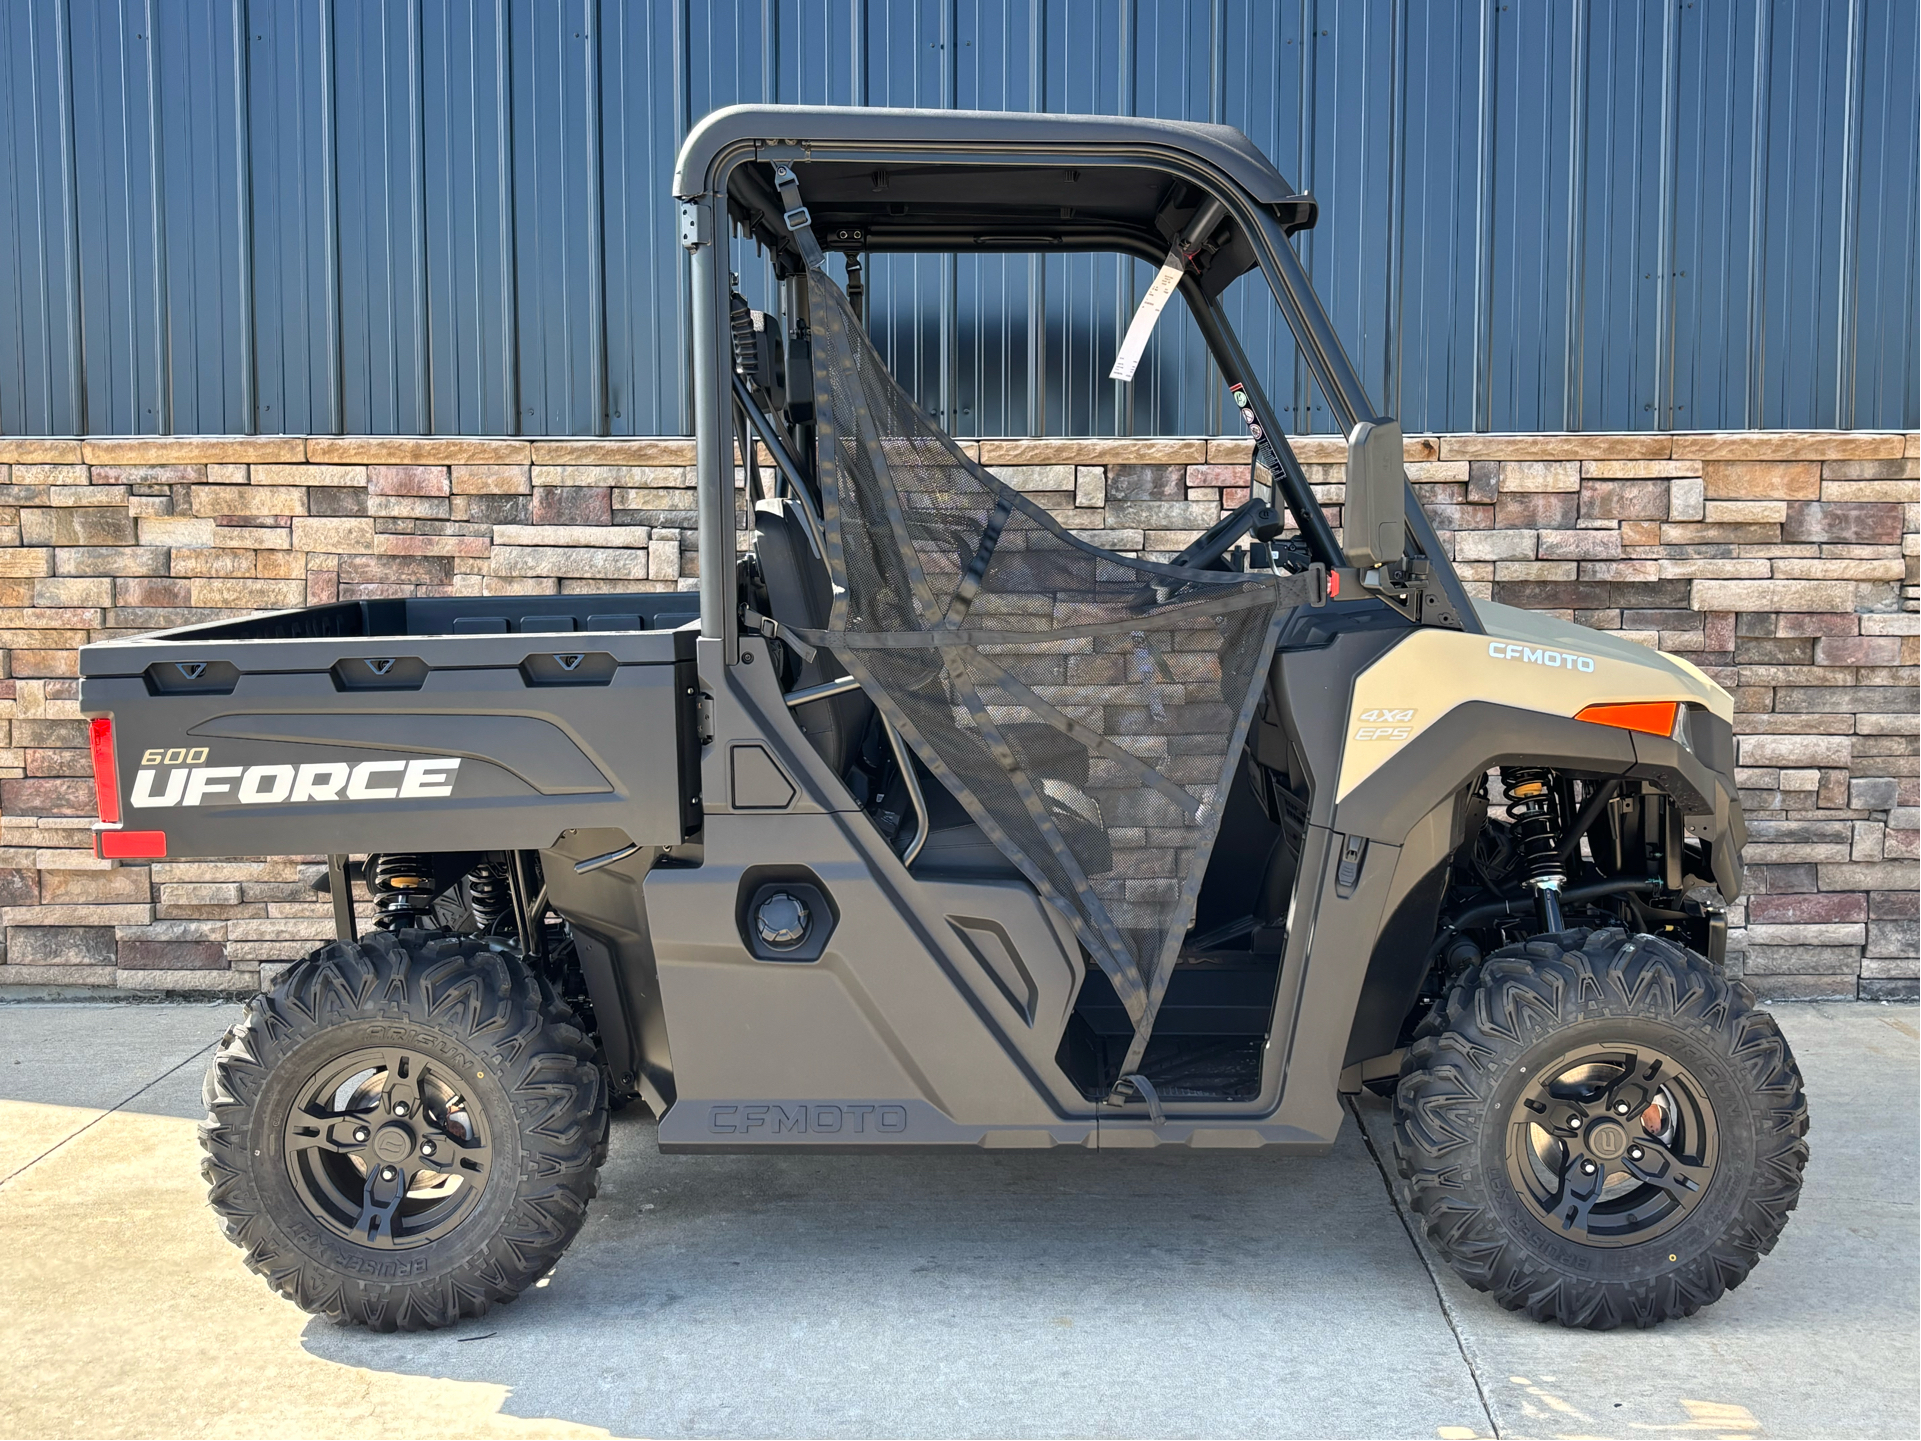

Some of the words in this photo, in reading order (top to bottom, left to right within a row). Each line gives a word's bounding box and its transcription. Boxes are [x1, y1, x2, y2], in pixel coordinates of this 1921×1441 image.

[1489, 643, 1595, 673] CFMOTO
[1360, 709, 1413, 723] 4X4
[1355, 726, 1410, 741] EPS
[142, 748, 209, 765] 600
[132, 758, 462, 808] UFORCE
[709, 1106, 907, 1133] CFMOTO
